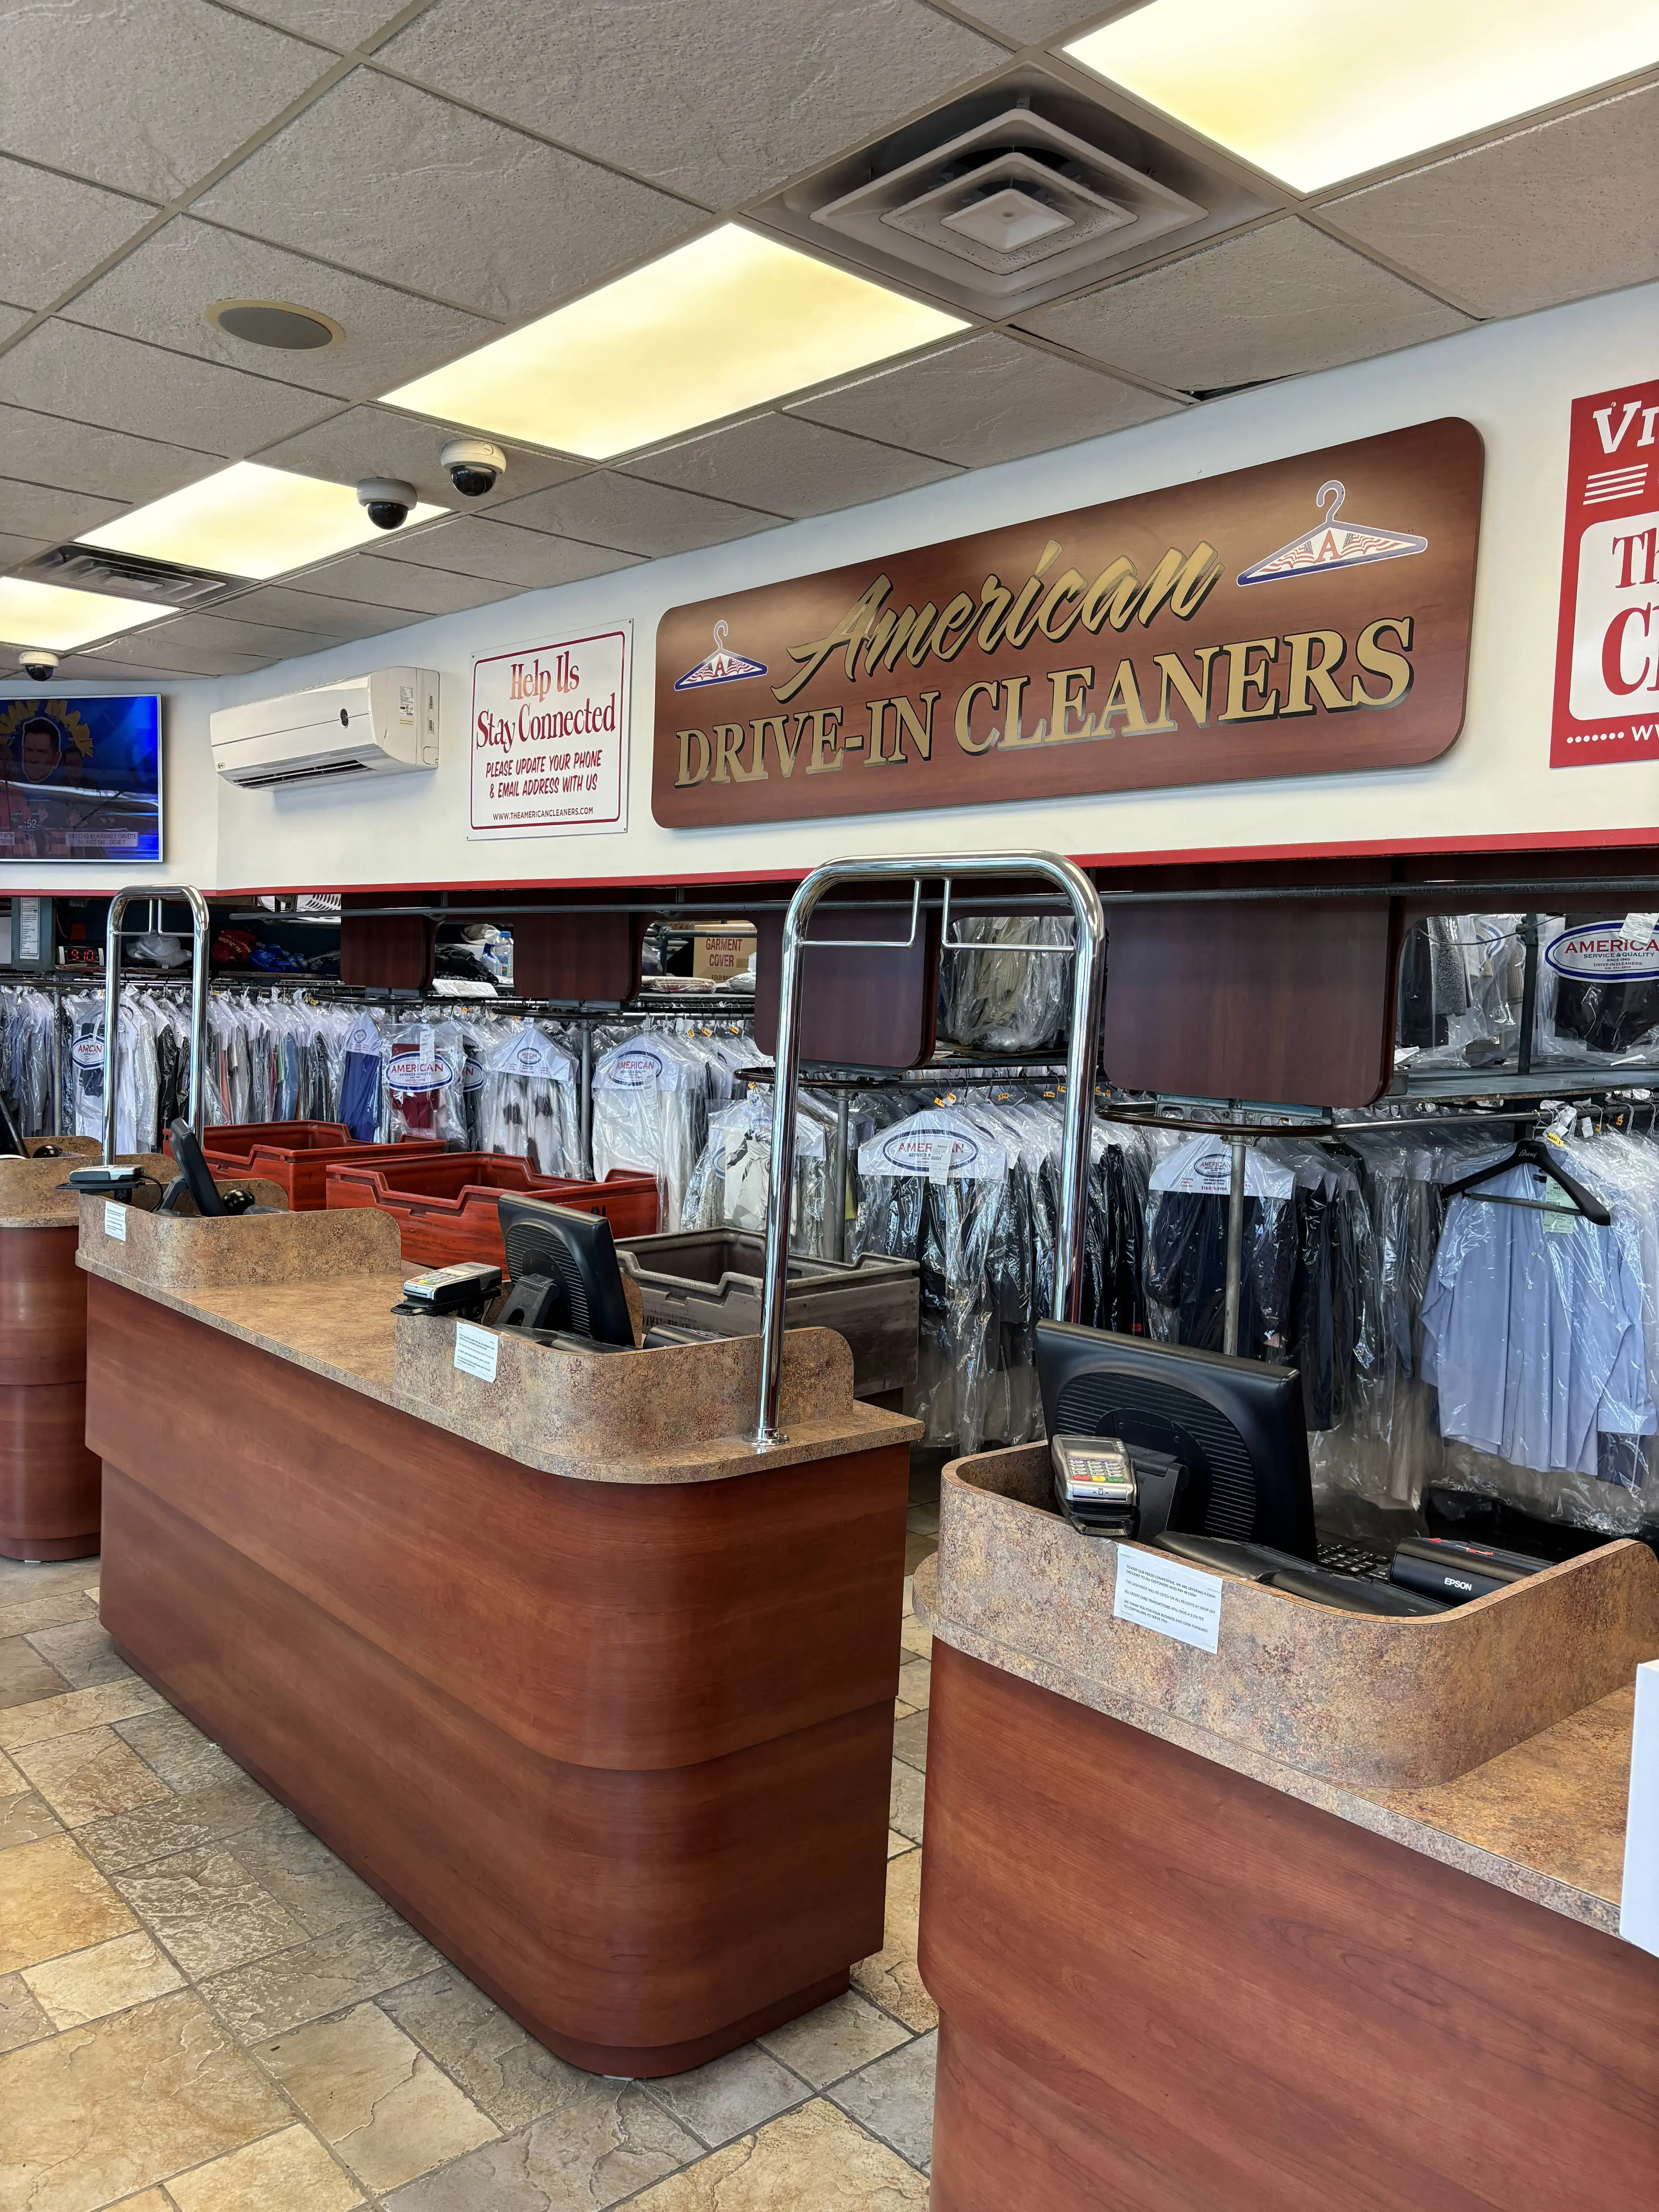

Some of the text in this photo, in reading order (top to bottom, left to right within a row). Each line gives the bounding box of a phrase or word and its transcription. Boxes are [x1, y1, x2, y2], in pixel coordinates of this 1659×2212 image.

[771, 539, 1225, 704] American
[509, 651, 579, 702] Help Us
[674, 617, 1414, 789] DRIVE-IN CLEANERS
[476, 709, 515, 754] Stay
[518, 692, 615, 742] Connected
[486, 749, 603, 778] PLEASE UPDATE YOUR PHONE
[489, 773, 598, 799] & EMAIL ADDRESS WITH US
[493, 807, 594, 821] WWW.THEAMERICANCLEANERS.COM
[706, 938, 742, 951] GARMENT
[709, 954, 734, 967] COVER
[391, 1064, 443, 1073] AMERICAN
[616, 1061, 654, 1069] AMERICAN
[898, 1143, 964, 1153] AMERN
[1151, 1579, 1168, 1588] CUSTOMERS
[1444, 1577, 1472, 1591] EPSON
[1149, 1599, 1170, 1609] TRANSACTIONS
[1128, 1606, 1146, 1616] CONTINUING
[1192, 1624, 1207, 1633] FORWARD
